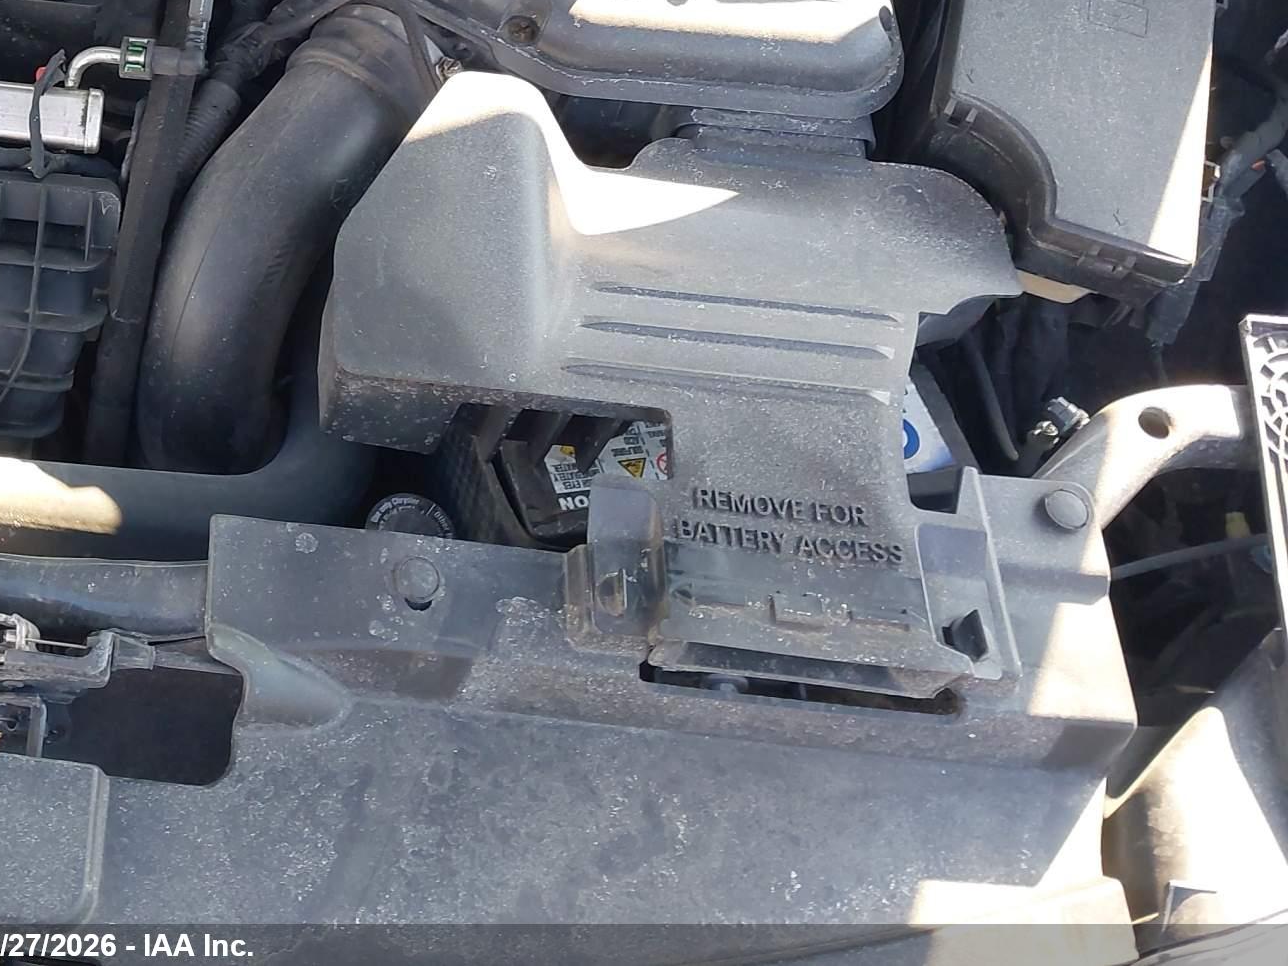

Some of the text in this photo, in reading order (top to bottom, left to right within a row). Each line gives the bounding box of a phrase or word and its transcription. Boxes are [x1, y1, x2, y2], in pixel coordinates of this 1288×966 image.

[693, 487, 869, 527] REMOVE FOR
[677, 518, 904, 564] BATTERY ACCESS
